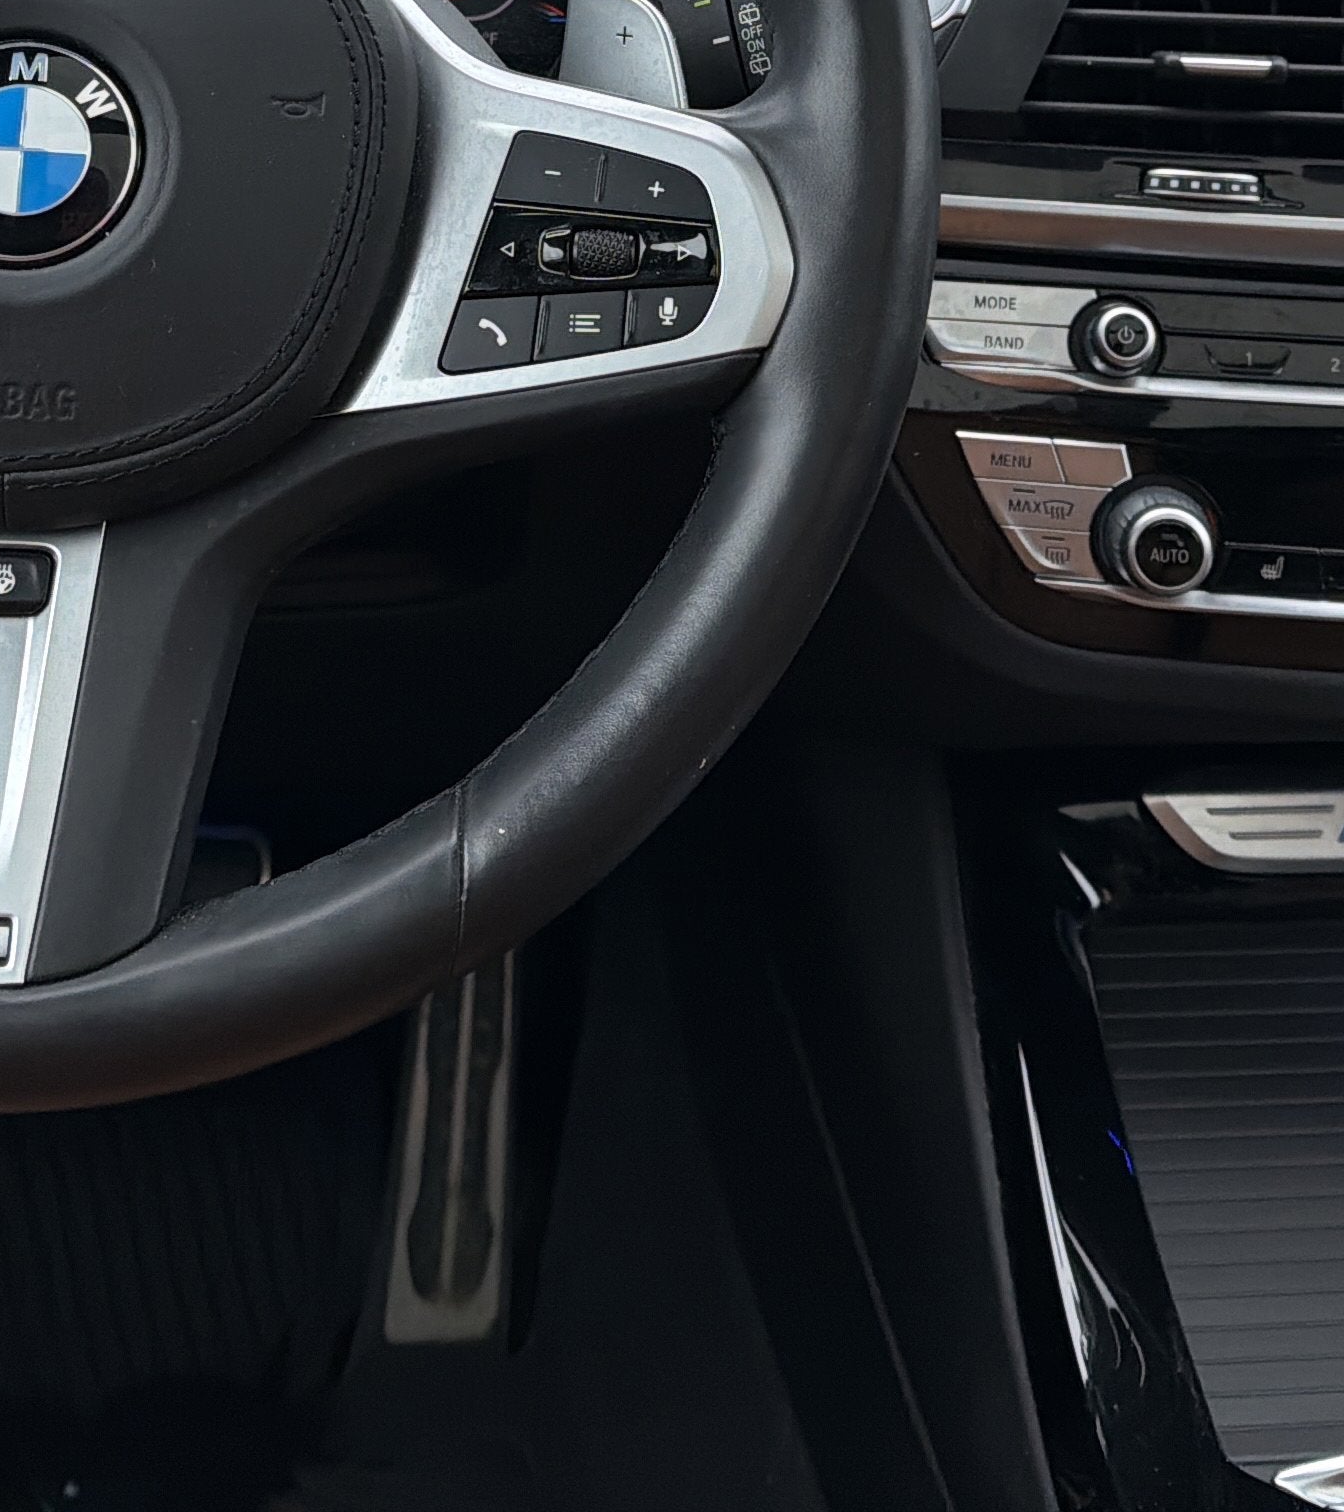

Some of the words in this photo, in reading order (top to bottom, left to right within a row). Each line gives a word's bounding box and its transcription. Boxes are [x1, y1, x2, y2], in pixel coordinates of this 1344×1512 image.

[740, 24, 764, 41] OFF
[746, 38, 765, 53] ON
[973, 295, 1017, 311] MODE
[984, 335, 1024, 350] BAND
[1245, 351, 1253, 367] 1
[1330, 358, 1341, 373] 2
[990, 452, 1032, 469] MENU
[1008, 499, 1041, 514] MAX
[1150, 548, 1189, 564] AUTO
